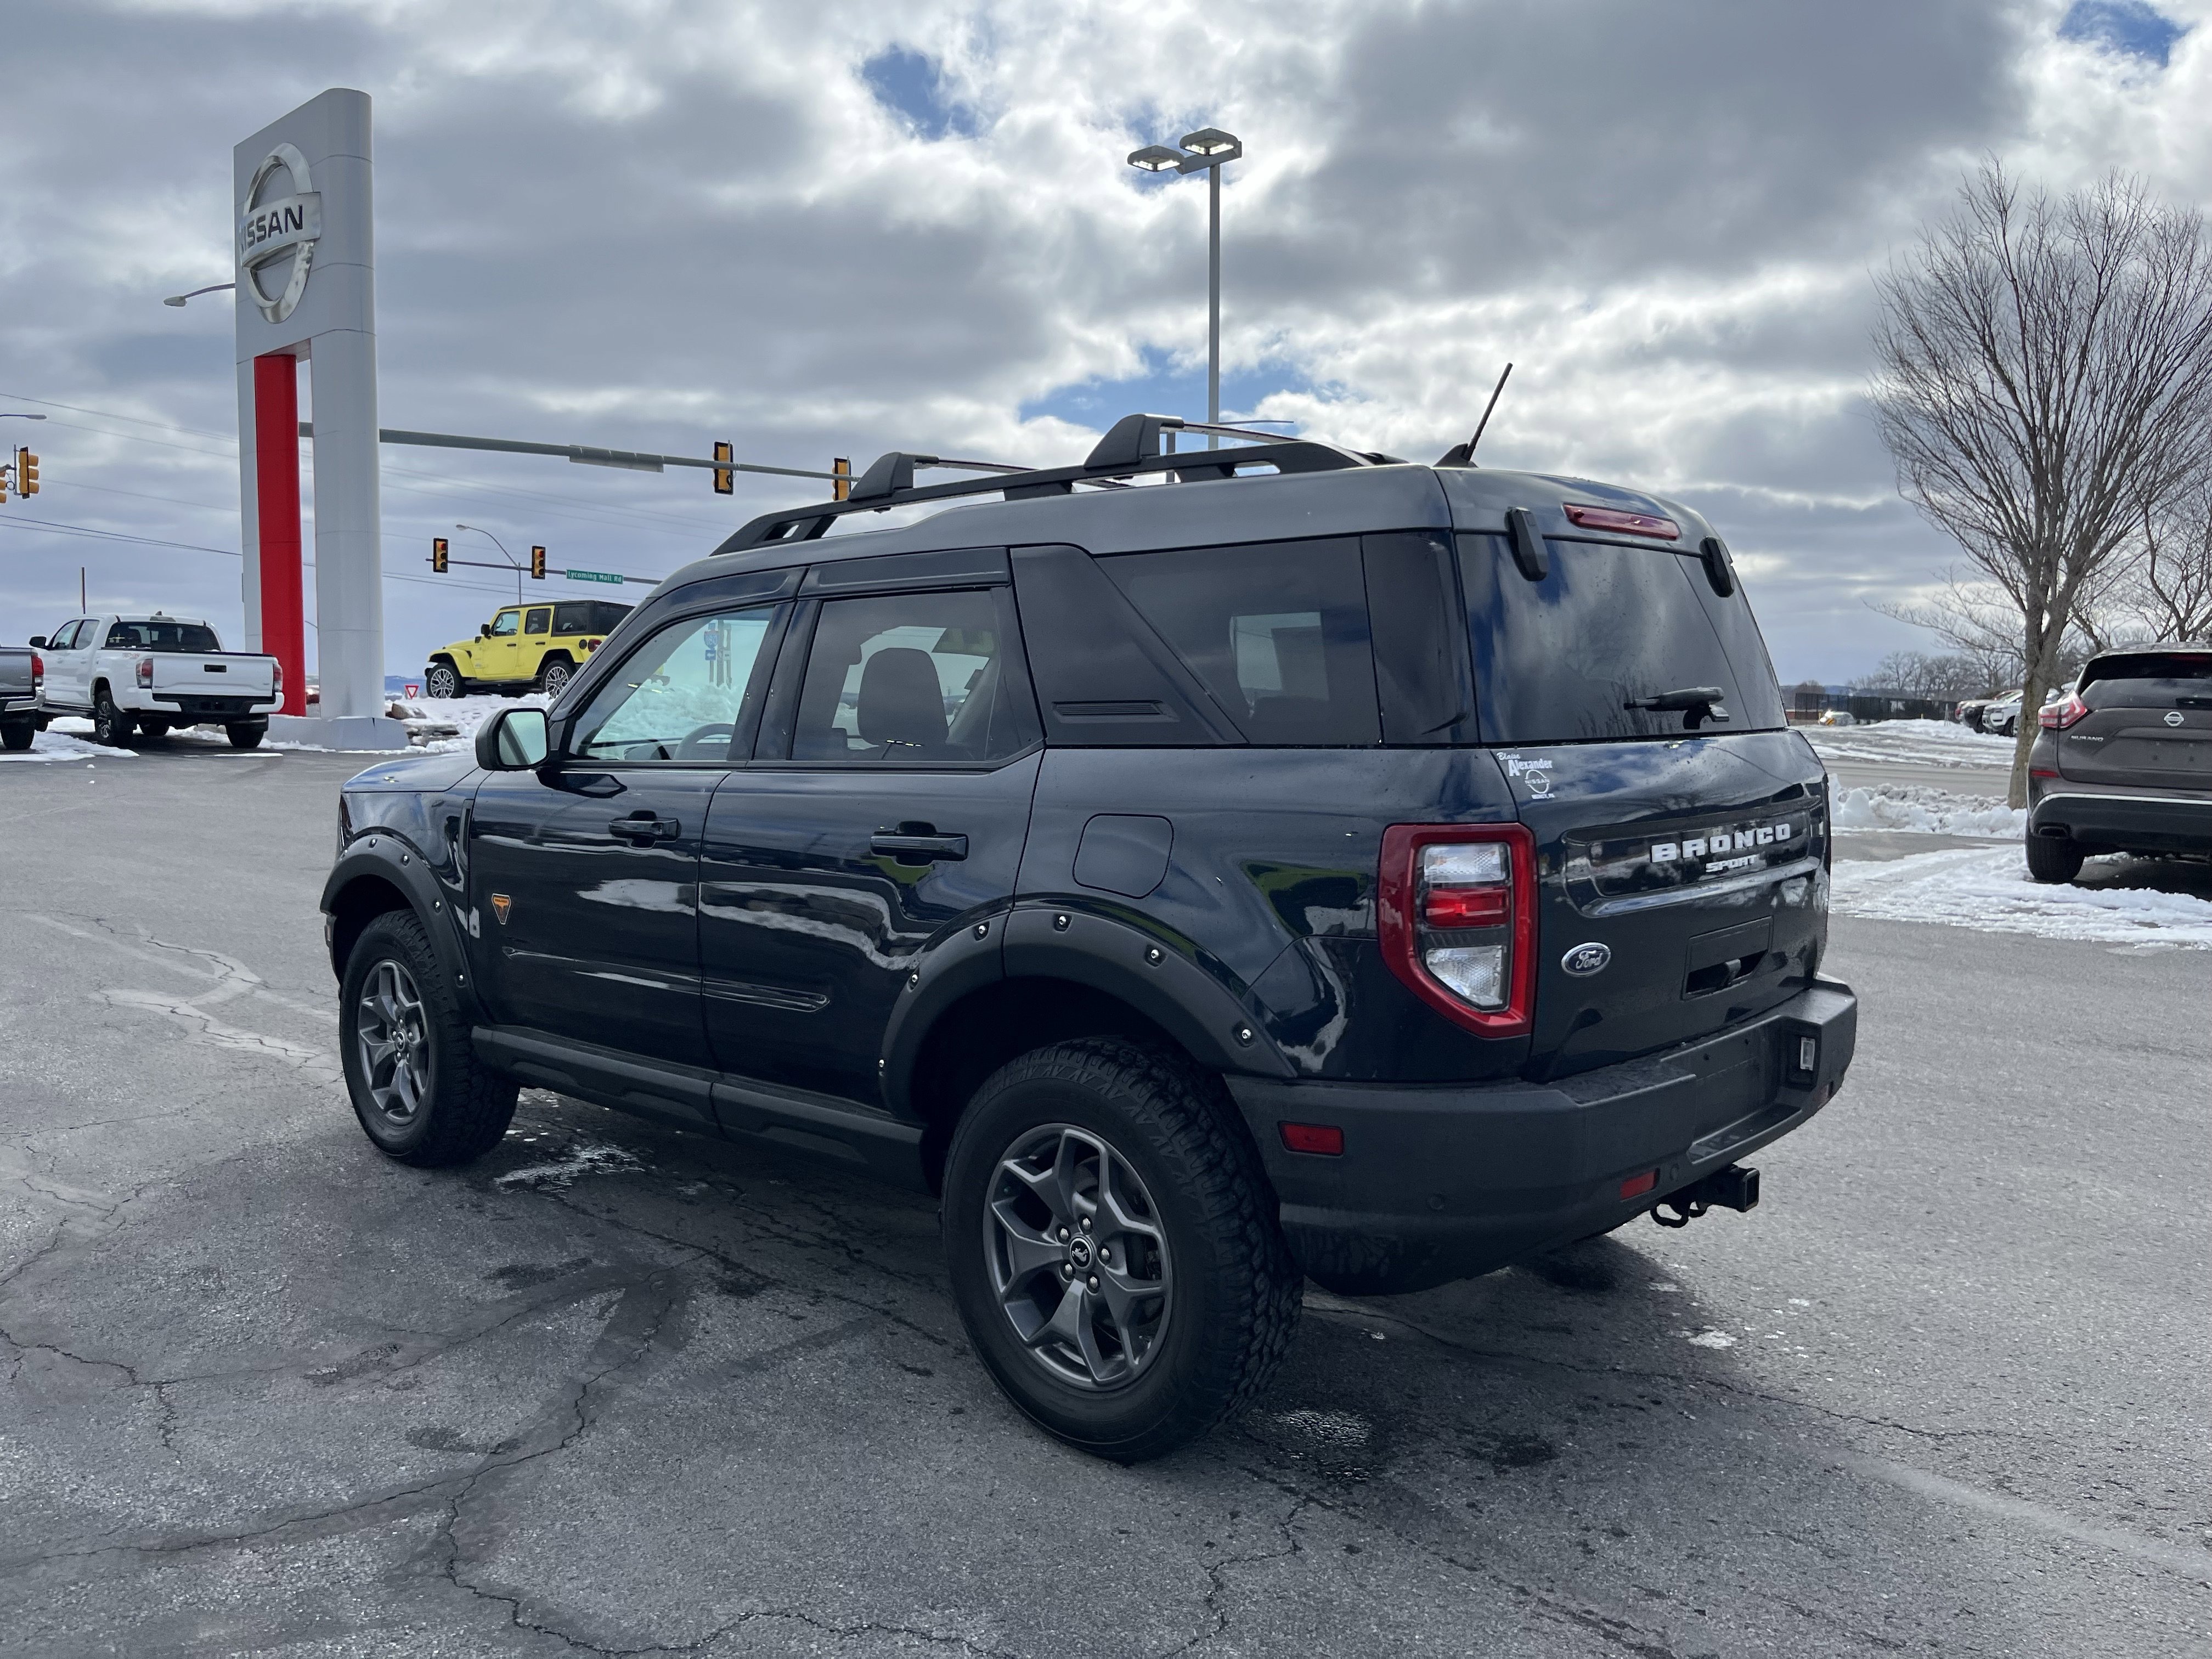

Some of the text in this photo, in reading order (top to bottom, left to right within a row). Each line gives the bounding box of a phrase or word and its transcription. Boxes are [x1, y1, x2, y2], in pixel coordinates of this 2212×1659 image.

[568, 571, 597, 581] Lycoming
[1508, 758, 1553, 777] Alexander
[1651, 823, 1791, 863] BRONCO
[1706, 854, 1757, 873] SPORT
[1576, 950, 1603, 969] Ford
